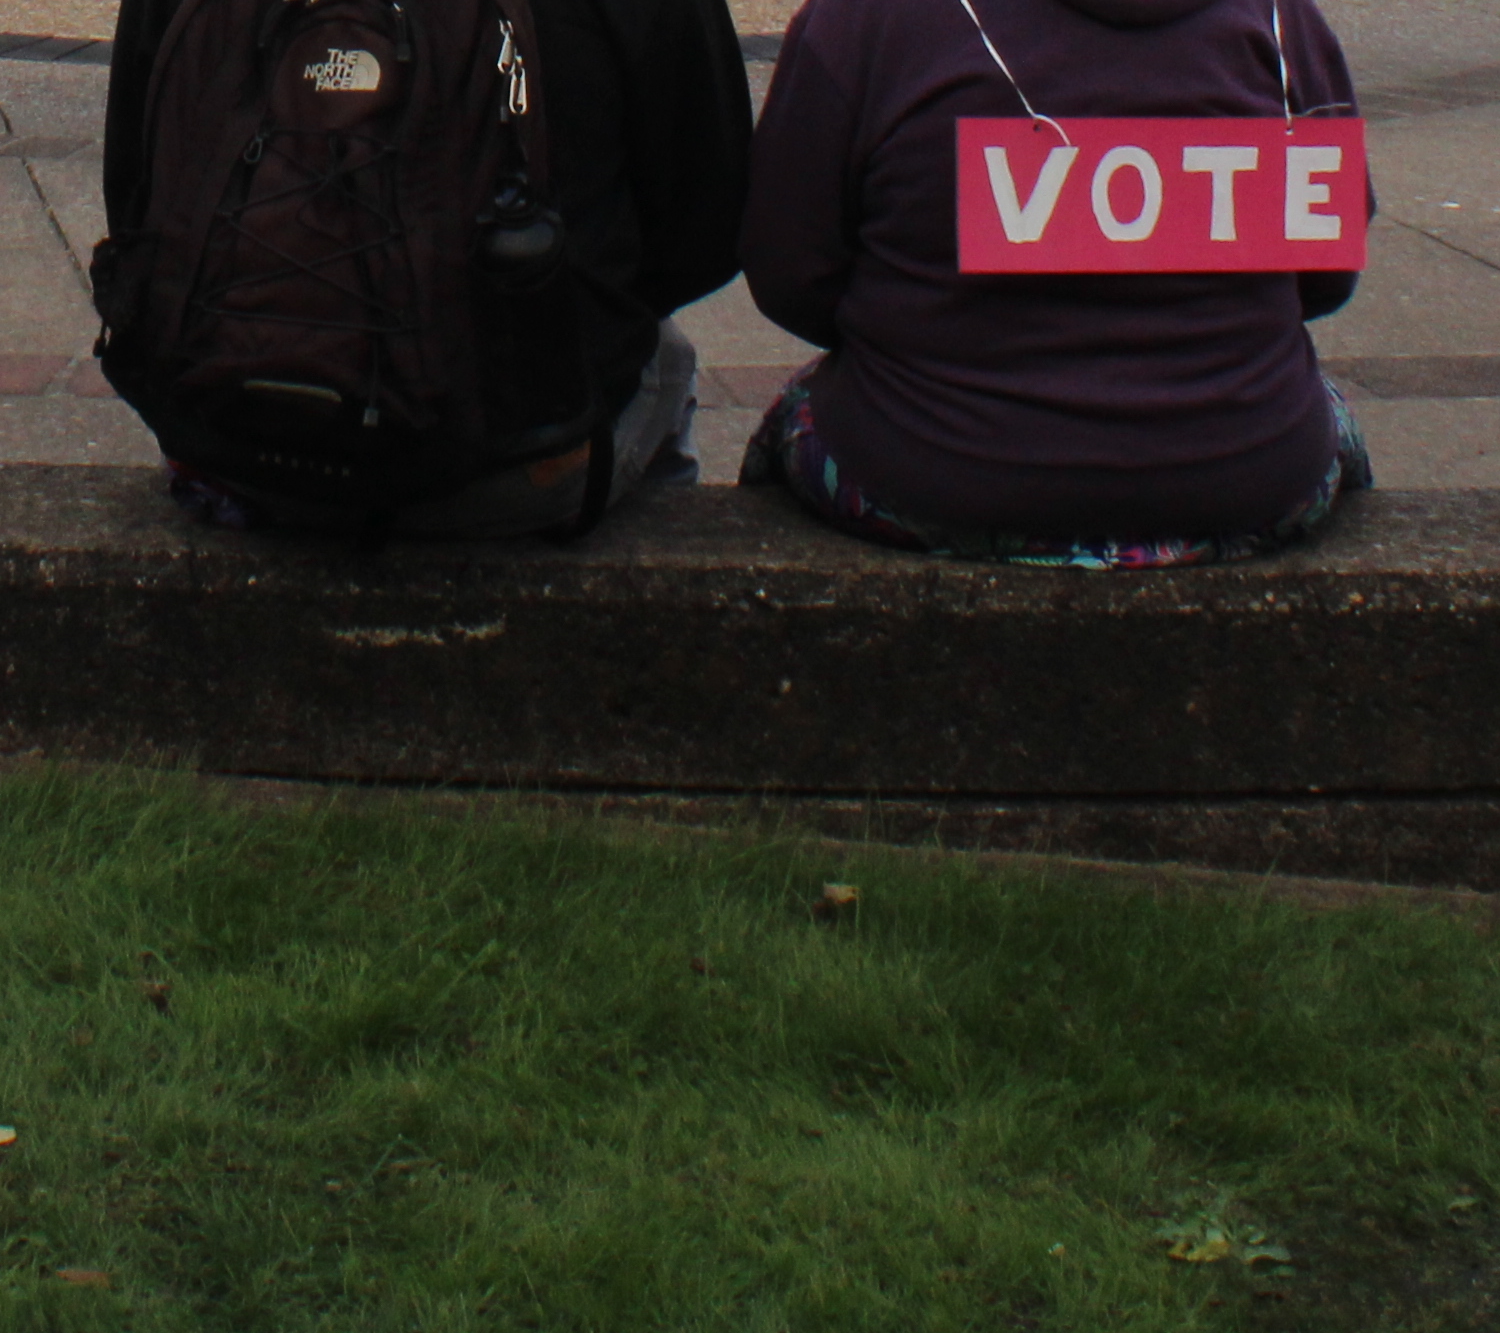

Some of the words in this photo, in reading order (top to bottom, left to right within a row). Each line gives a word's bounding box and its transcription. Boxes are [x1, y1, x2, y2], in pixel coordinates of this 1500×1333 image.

[327, 48, 358, 65] THE
[303, 62, 354, 80] NORTH
[315, 77, 352, 91] FACE
[983, 145, 1342, 243] VOTE
